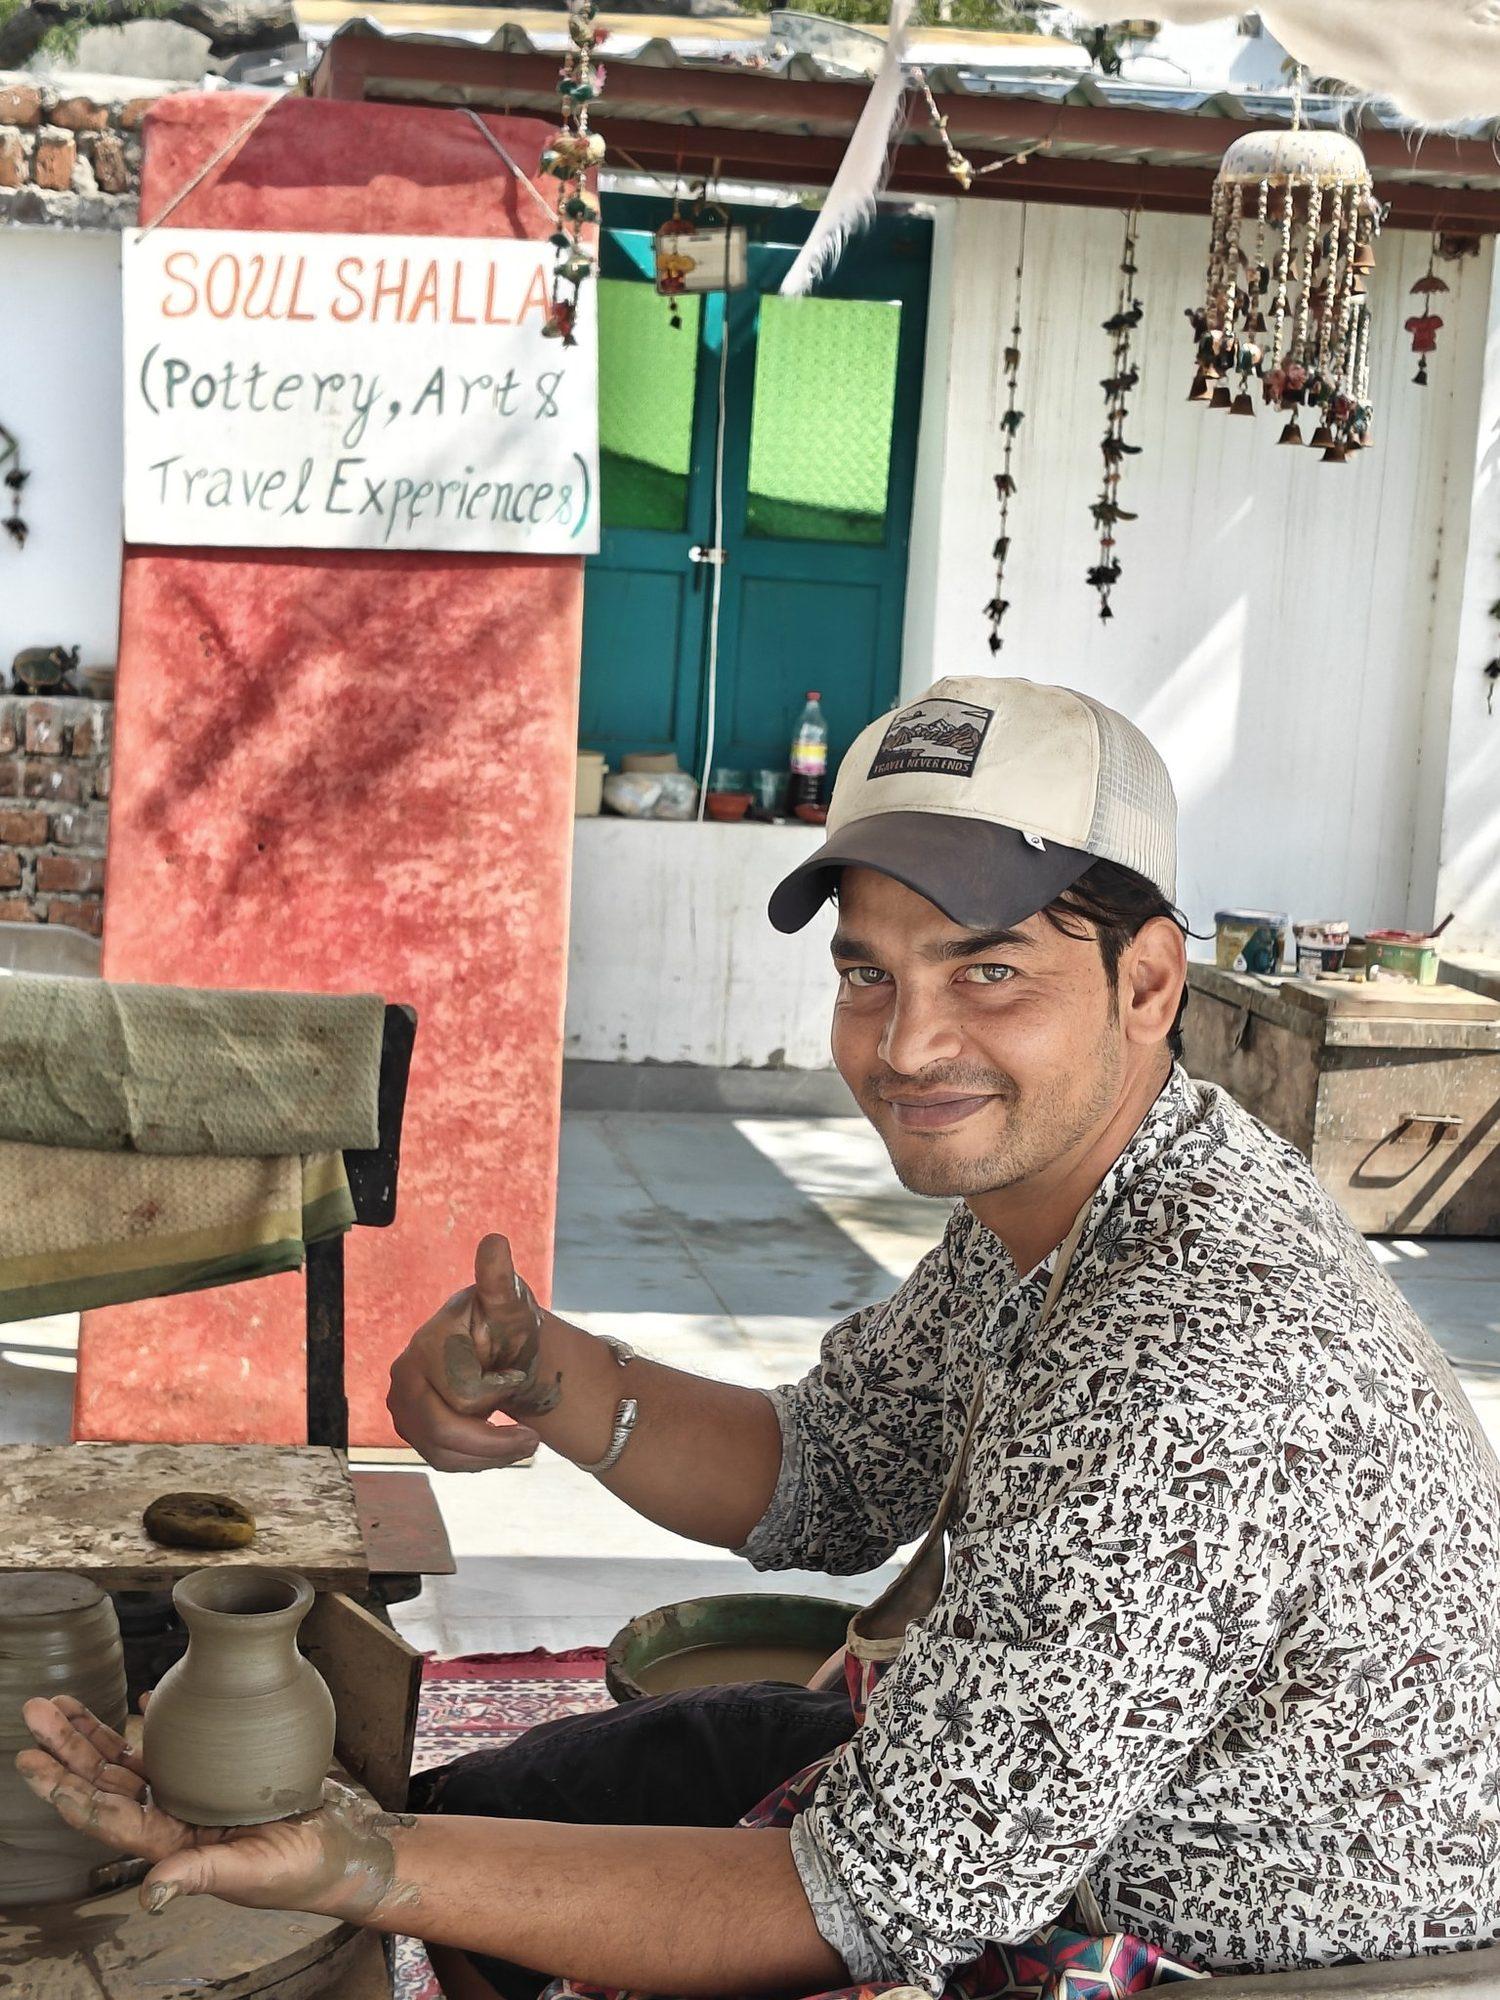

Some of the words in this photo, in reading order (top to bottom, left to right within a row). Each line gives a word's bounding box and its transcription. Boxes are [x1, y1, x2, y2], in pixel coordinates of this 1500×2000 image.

[149, 455, 313, 515] Travel
[874, 760, 904, 774] TRAVEL
[906, 758, 939, 769] NEVER
[940, 760, 971, 773] ENDS
